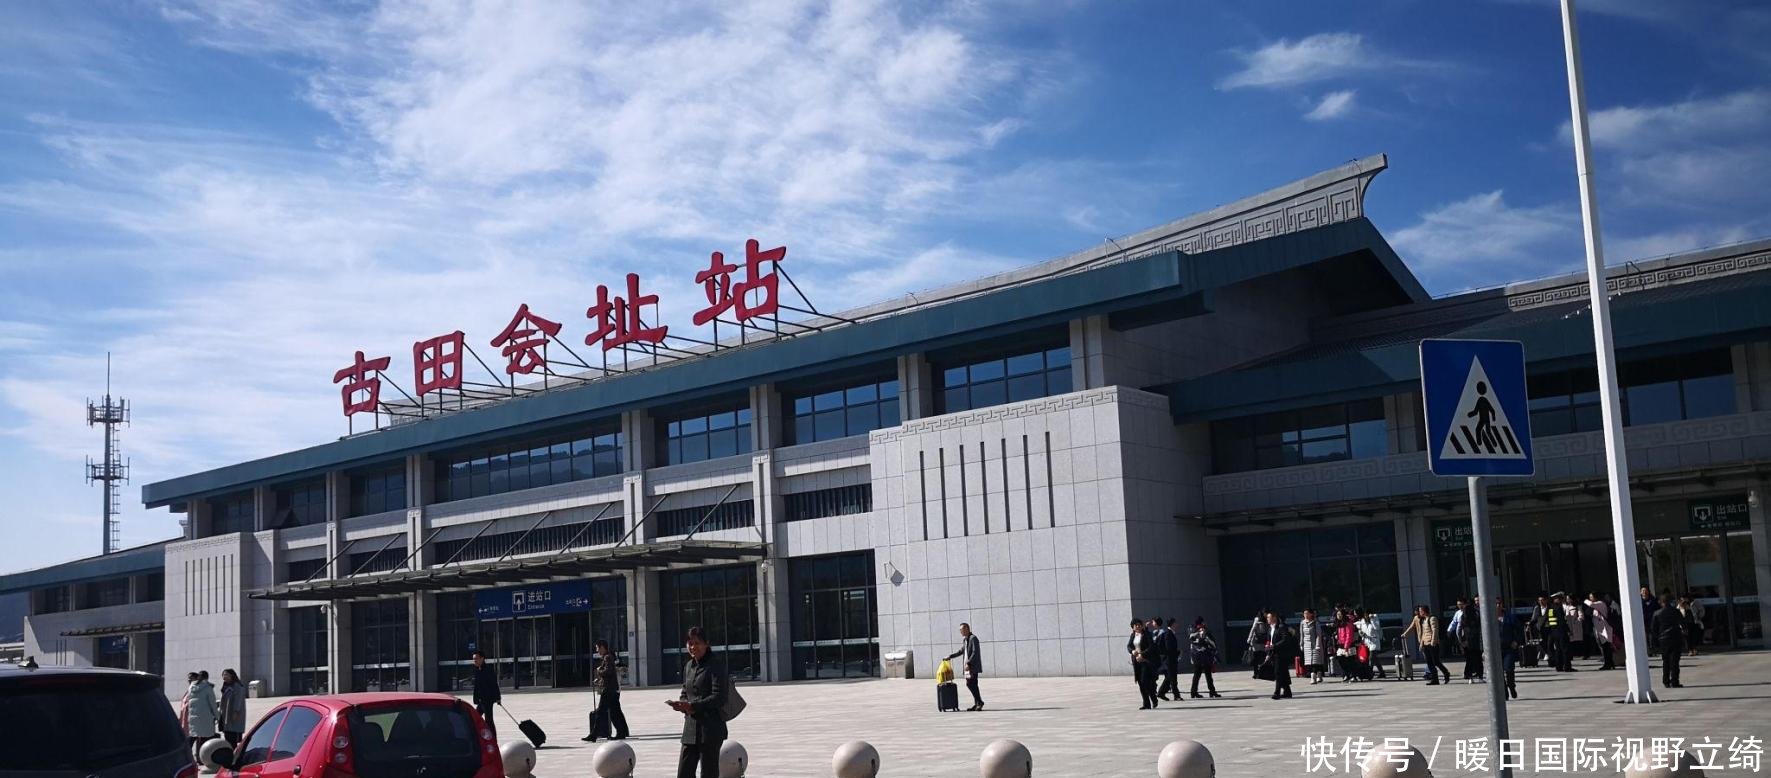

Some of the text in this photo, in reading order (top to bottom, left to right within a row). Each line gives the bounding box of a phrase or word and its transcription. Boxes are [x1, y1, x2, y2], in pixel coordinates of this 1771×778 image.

[333, 238, 786, 416] 古田会址站
[1716, 503, 1747, 514] 出站口
[527, 590, 551, 603] 进站口
